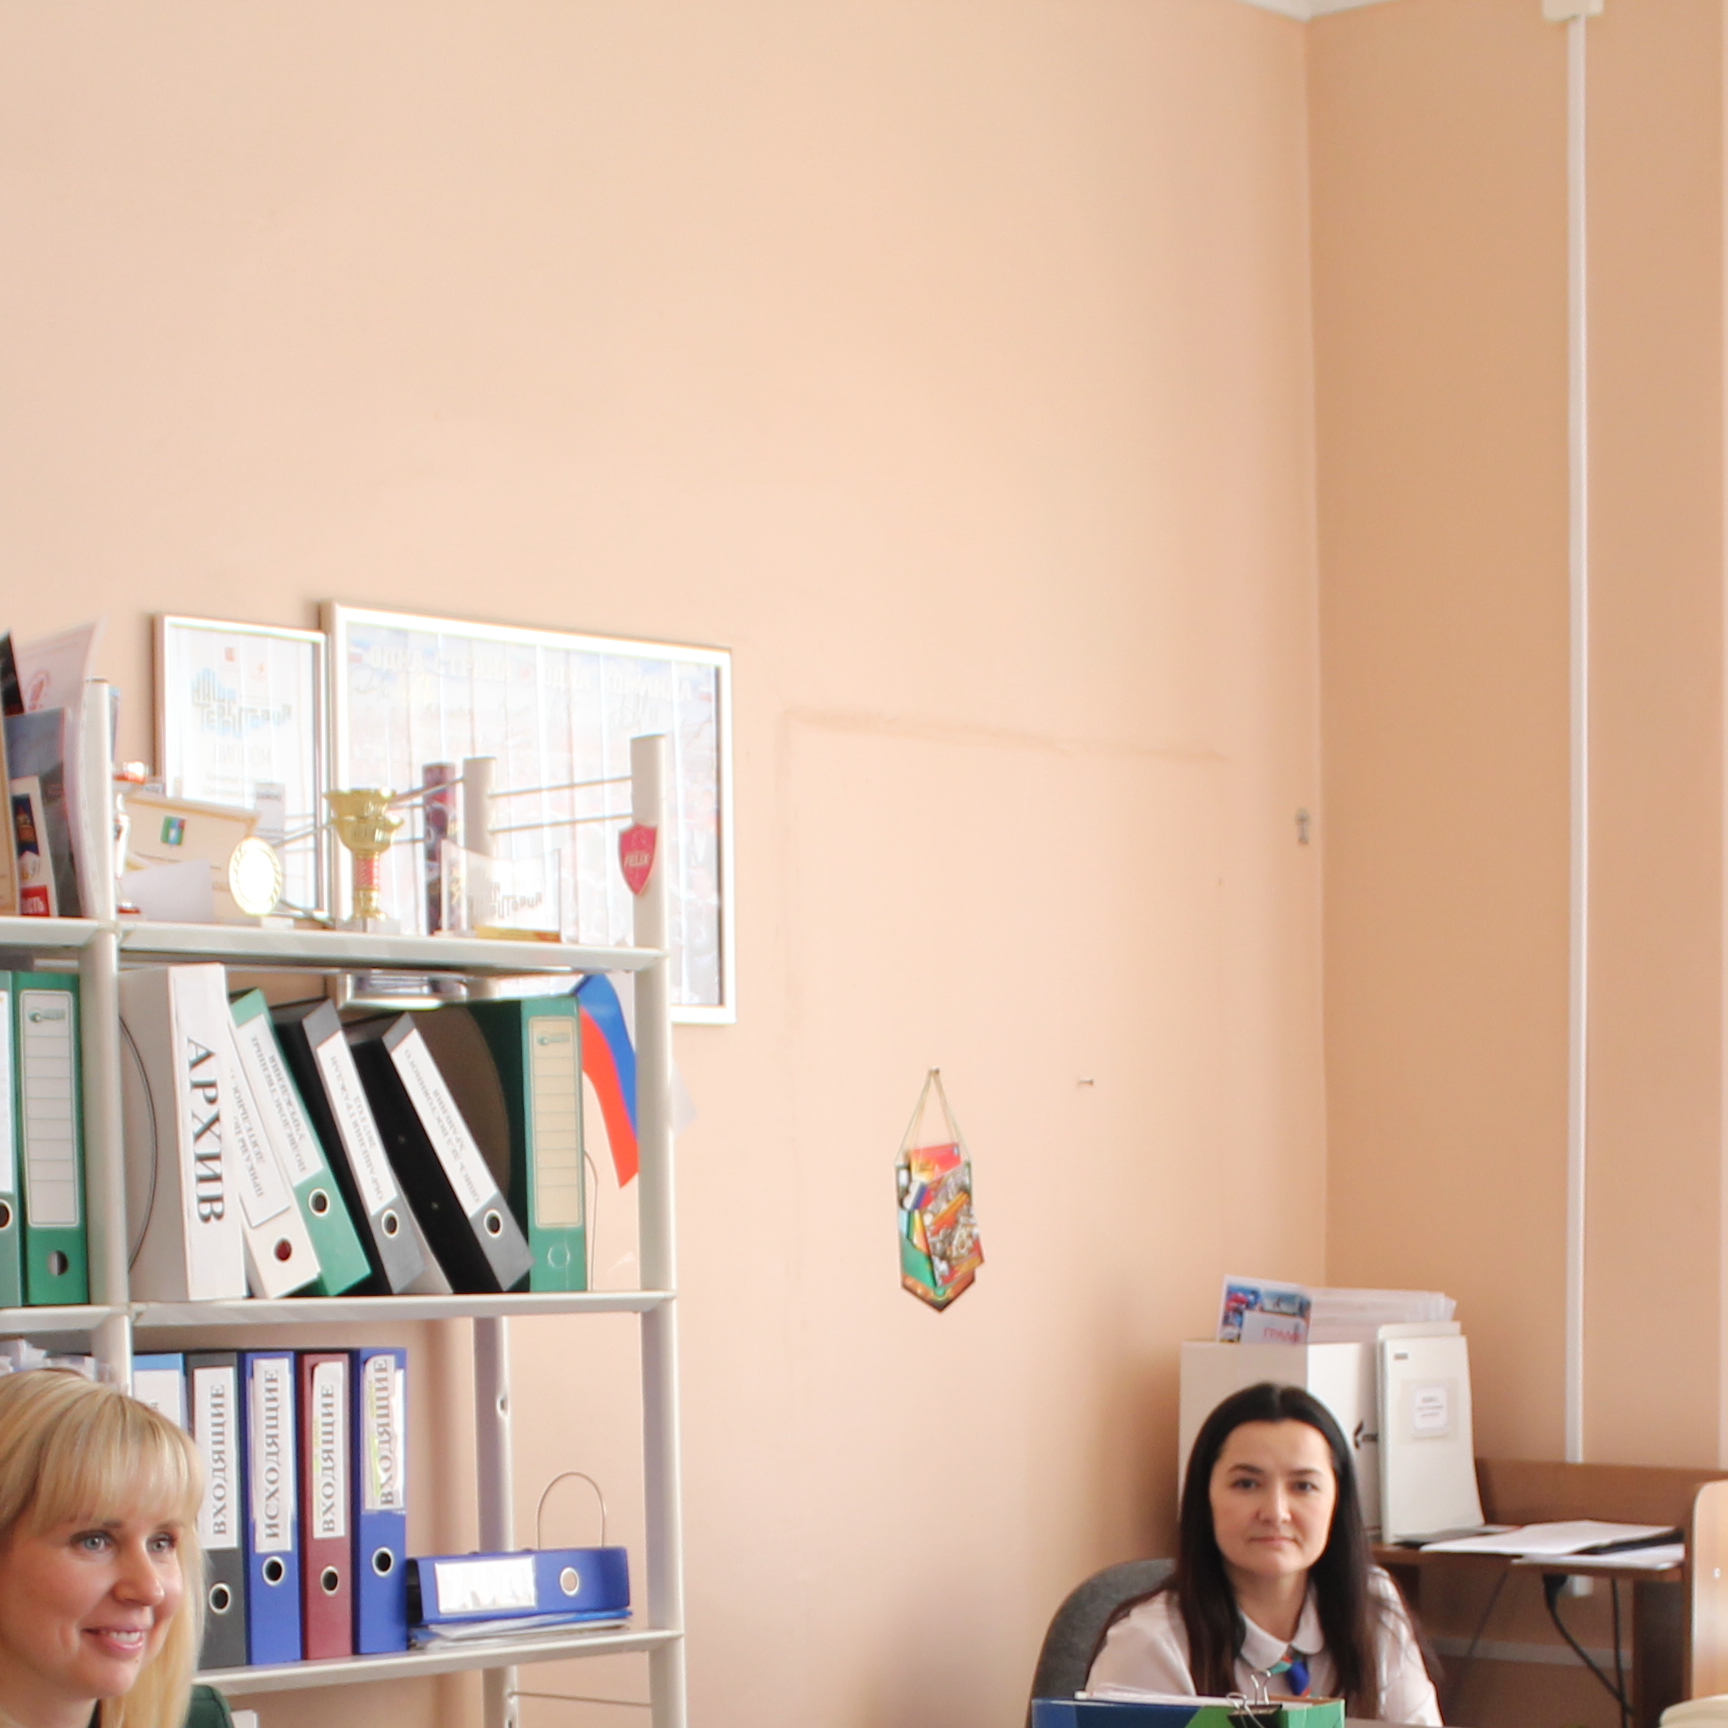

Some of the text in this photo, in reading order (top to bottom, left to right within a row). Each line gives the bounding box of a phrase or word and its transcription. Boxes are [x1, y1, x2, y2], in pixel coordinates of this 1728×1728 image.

[623, 852, 653, 868] FELIX
[186, 1036, 225, 1225] АРХИВ
[210, 1384, 229, 1536] ВХОДЯЩИЕ
[264, 1368, 284, 1540] ИСХОДЯЩИЕ
[320, 1385, 339, 1534] ВХОДЯЩИЕ
[373, 1358, 395, 1506] ВХОДЯЩИЕ
